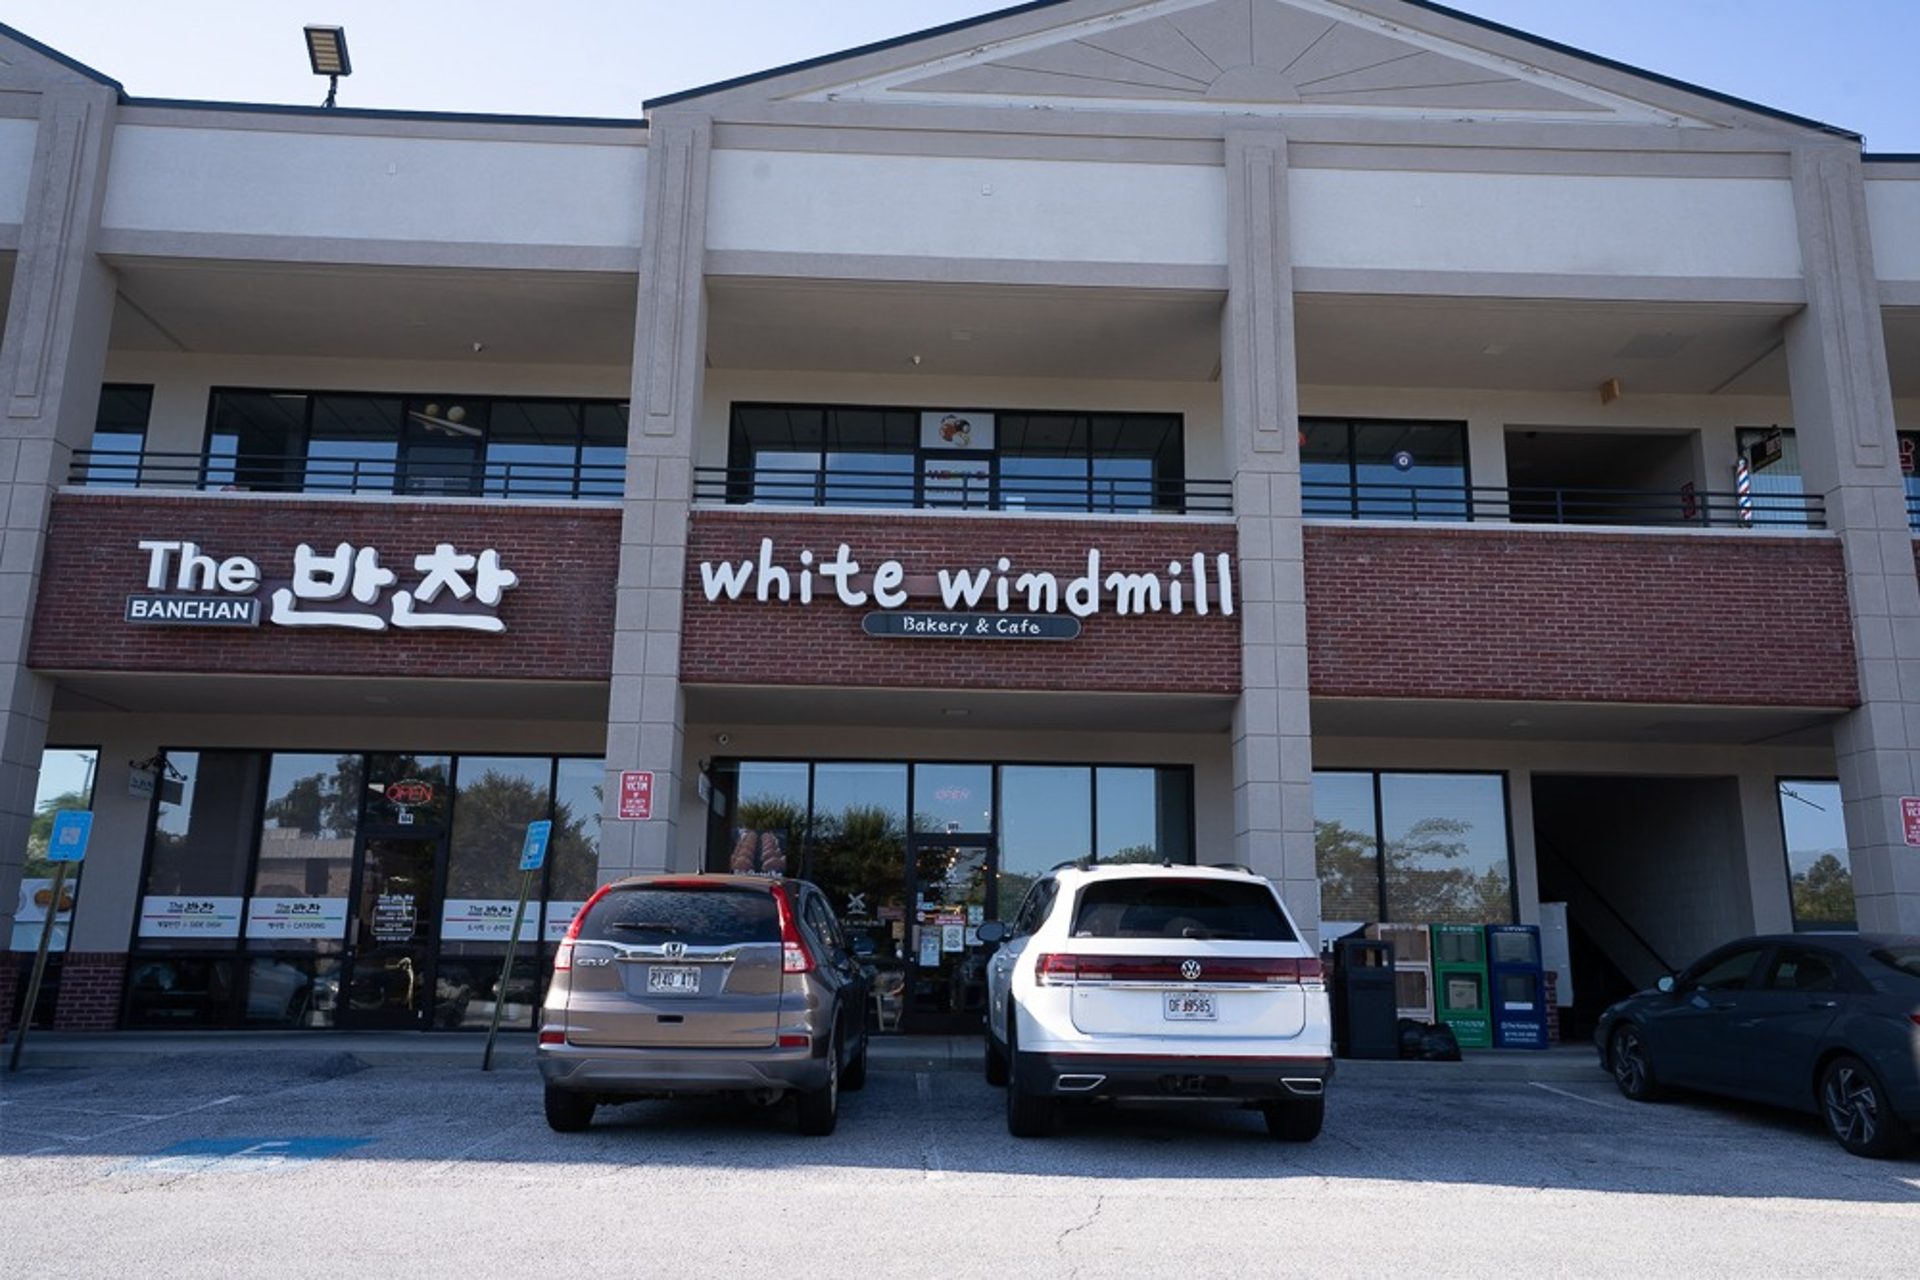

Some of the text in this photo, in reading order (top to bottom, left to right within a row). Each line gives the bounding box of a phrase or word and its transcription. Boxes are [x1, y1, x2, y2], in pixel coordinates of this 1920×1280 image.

[138, 541, 261, 592] The
[700, 538, 1234, 616] white windmill
[271, 541, 518, 632] 반찬
[131, 600, 249, 620] BANCHAN
[903, 616, 1041, 636] Bakery & Cafe
[386, 786, 432, 801] OPEN
